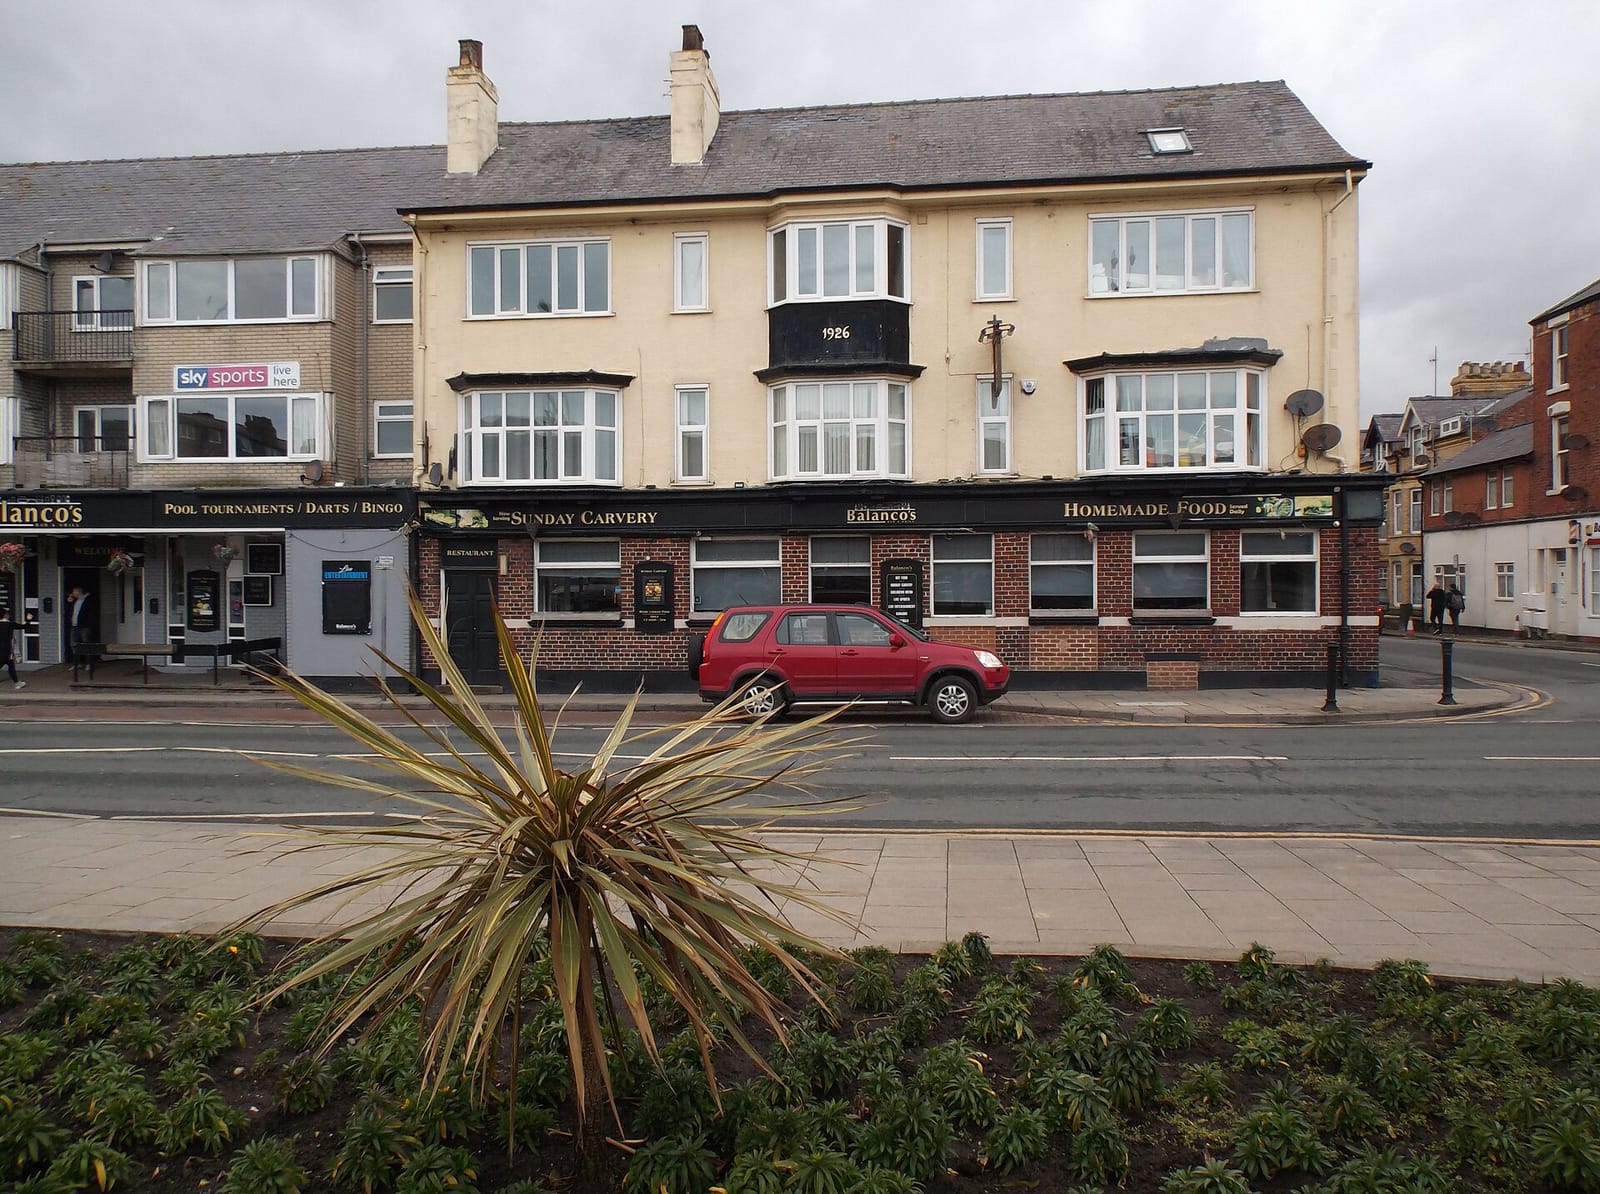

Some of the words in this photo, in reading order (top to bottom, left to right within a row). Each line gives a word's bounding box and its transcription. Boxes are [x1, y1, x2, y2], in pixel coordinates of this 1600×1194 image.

[822, 325, 850, 341] 1926
[181, 369, 207, 386] sky
[212, 369, 265, 386] sports
[273, 365, 292, 375] live
[273, 377, 298, 386] here
[164, 503, 198, 515] POOL
[202, 503, 294, 514] TOURNAMENTS
[305, 502, 350, 514] DARTS
[361, 501, 403, 514] BINGO
[847, 508, 917, 521] Balanco's
[1063, 502, 1169, 517] HOMEMADE
[1177, 501, 1227, 516] FOOD
[510, 511, 575, 526] SUNDAY
[580, 510, 658, 525] CARVERY
